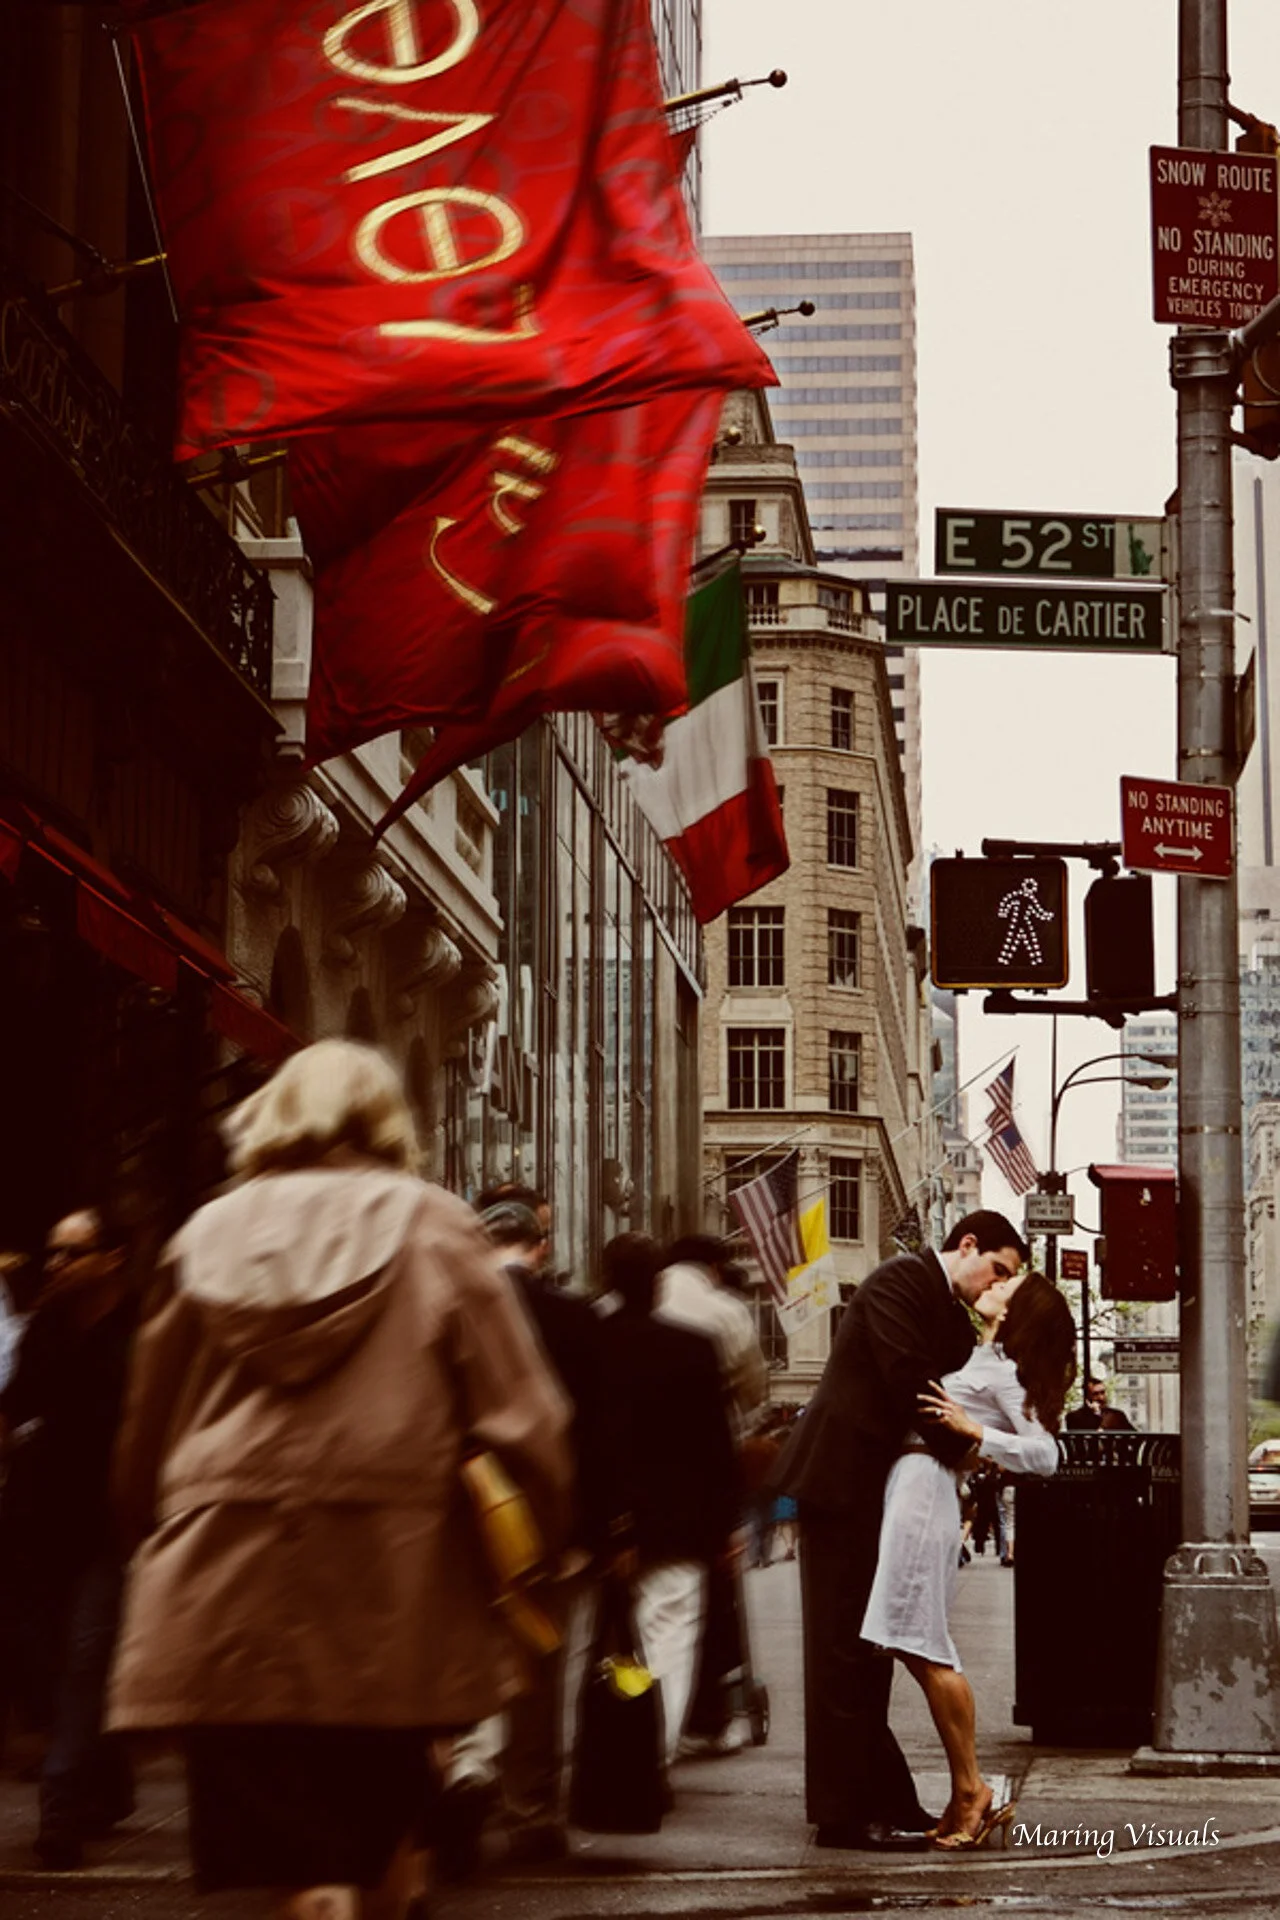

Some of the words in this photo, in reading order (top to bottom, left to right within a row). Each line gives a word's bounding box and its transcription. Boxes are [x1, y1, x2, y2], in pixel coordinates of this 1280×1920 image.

[1157, 159, 1206, 187] SNOW
[1217, 164, 1272, 193] ROUTE
[1157, 226, 1181, 252] NO
[1193, 229, 1274, 261] STANDING
[1188, 257, 1245, 279] DURING
[1169, 276, 1264, 301] EMERGENCY
[1167, 296, 1222, 319] VEHICLES
[1229, 302, 1264, 320] TOWE
[946, 518, 976, 567] E
[1001, 520, 1072, 570] 52
[1081, 523, 1115, 549] ST
[898, 595, 984, 633] PLACE
[998, 606, 1025, 635] DE
[1036, 600, 1146, 639] CARTIER
[1128, 790, 1148, 809] NO
[1155, 793, 1224, 818] STANDING
[1141, 816, 1214, 840] ANYTIME
